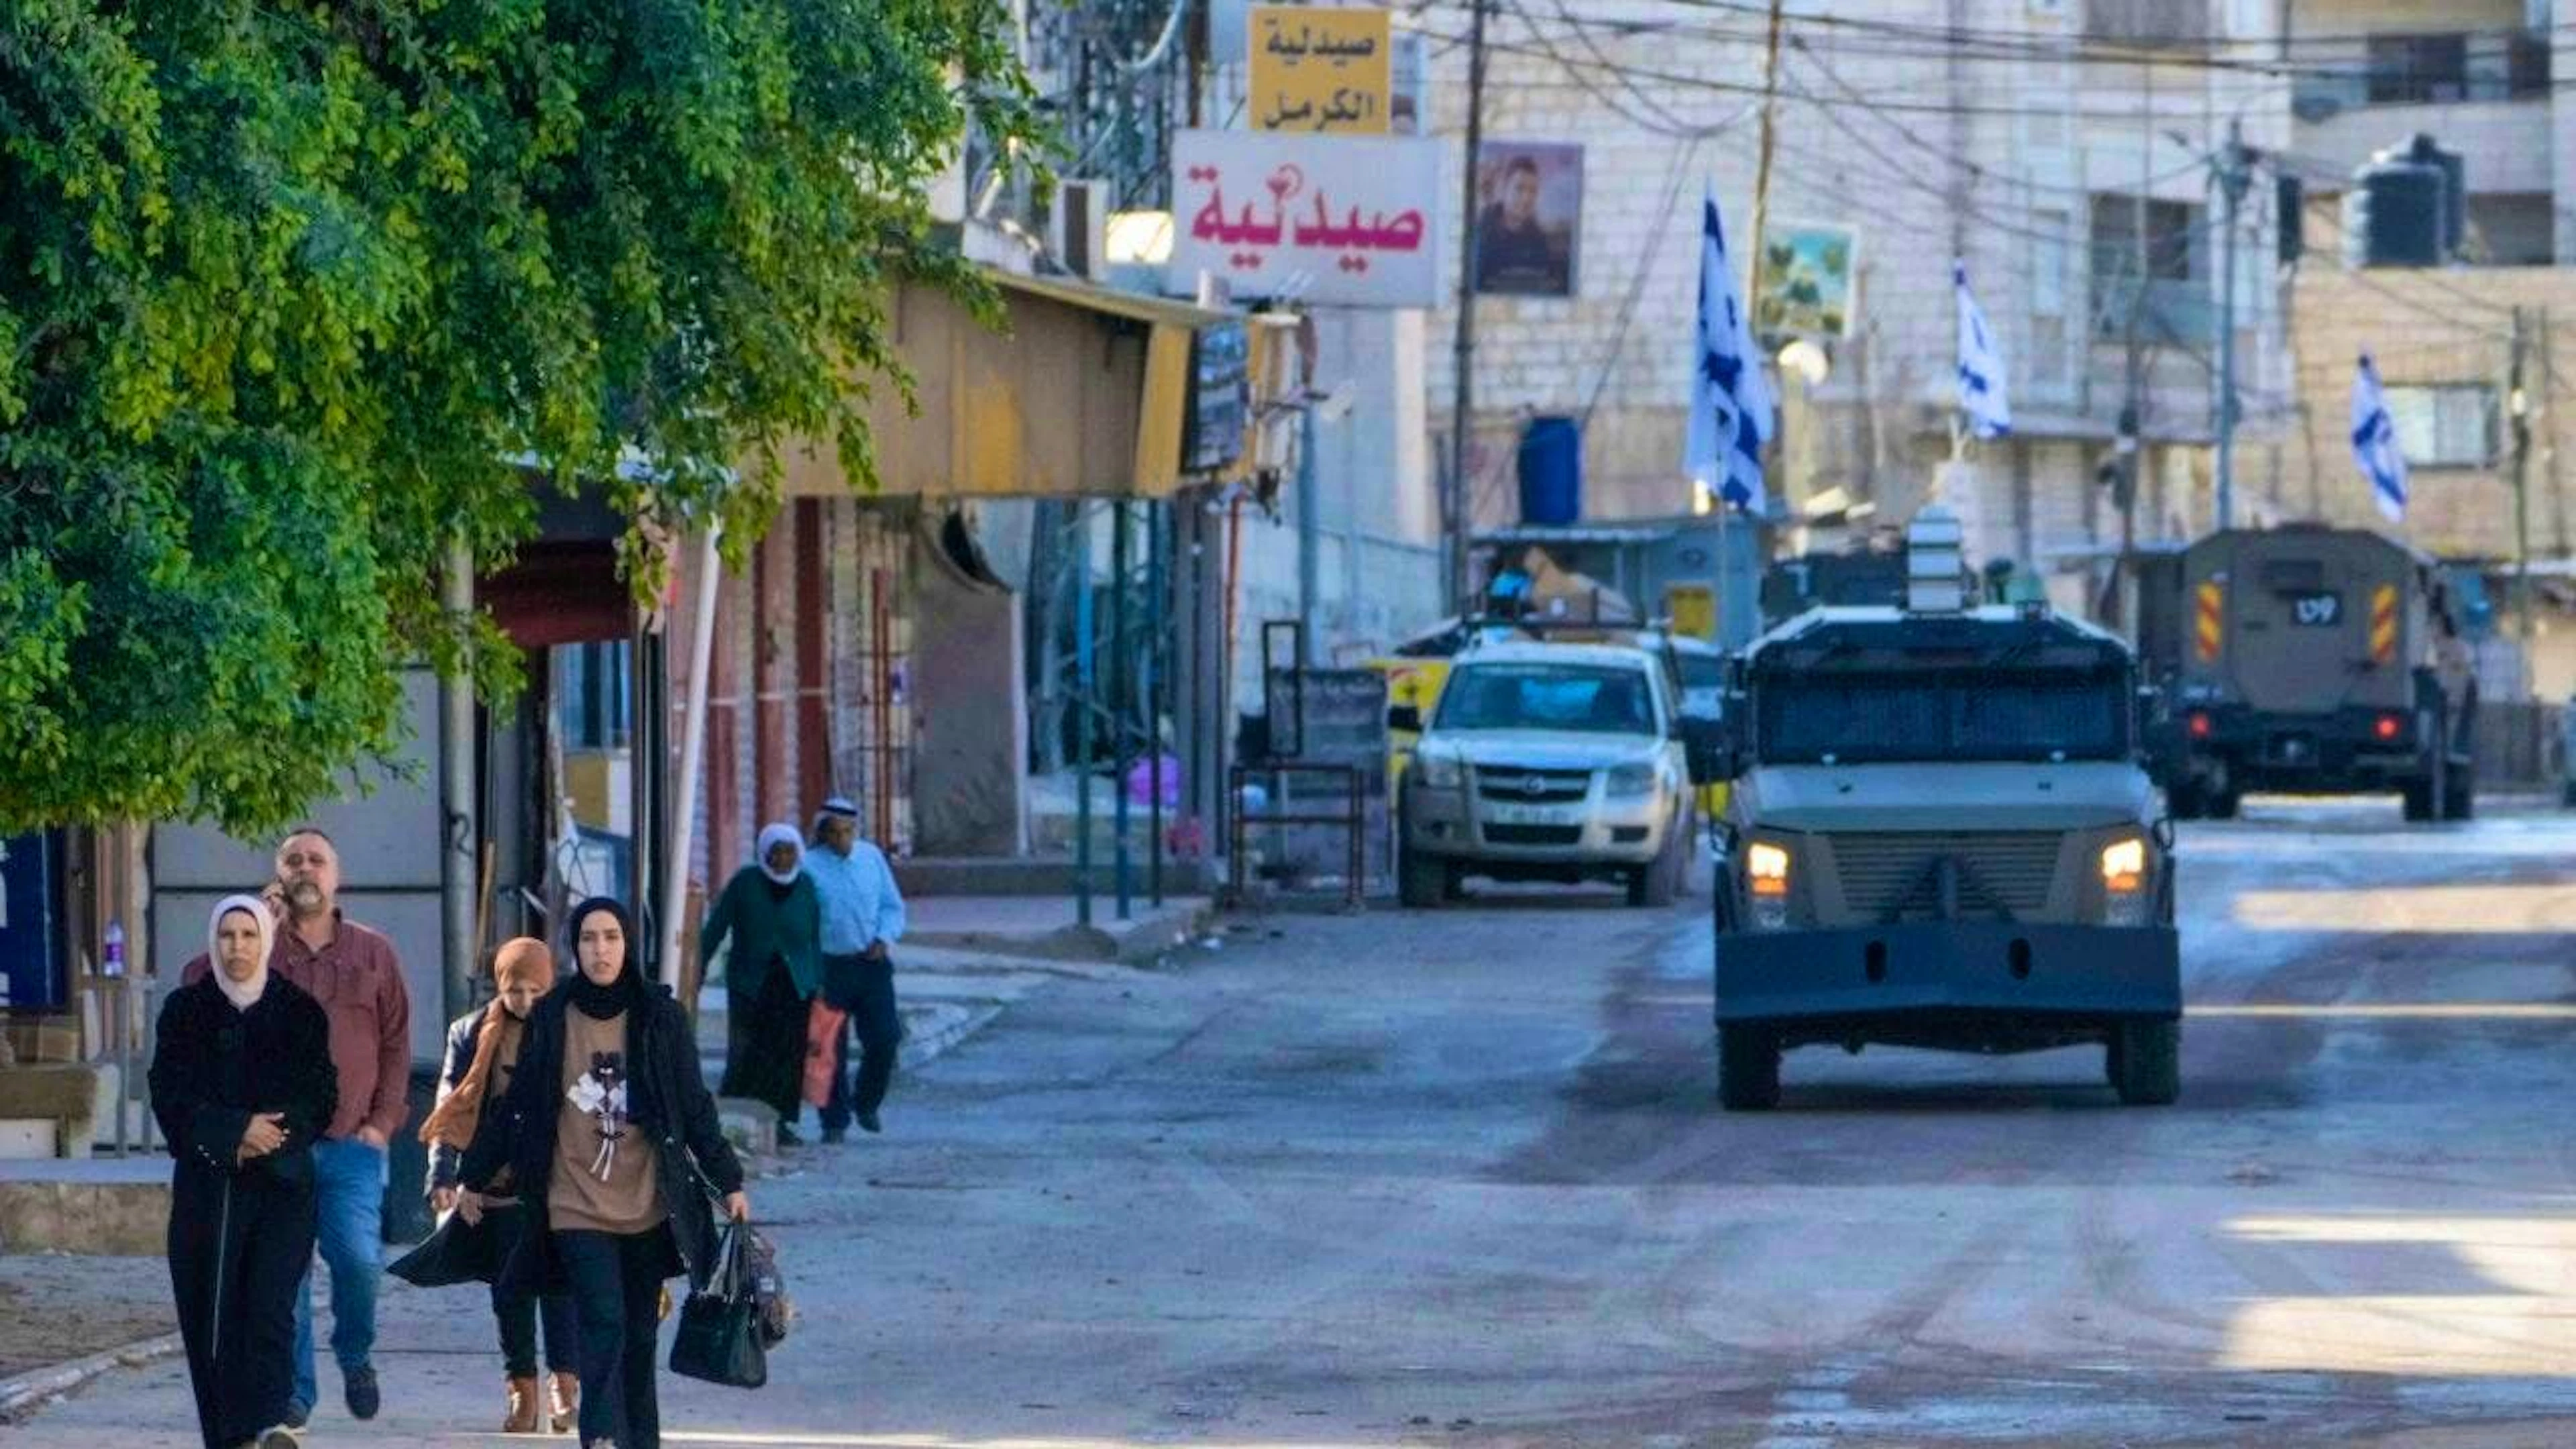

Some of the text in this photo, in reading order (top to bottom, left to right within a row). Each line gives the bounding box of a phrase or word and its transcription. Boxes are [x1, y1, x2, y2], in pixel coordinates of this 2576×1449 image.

[1264, 18, 1375, 66] صيدلية
[1264, 88, 1374, 131] الكرمل
[1188, 163, 1424, 272] صيدلية
